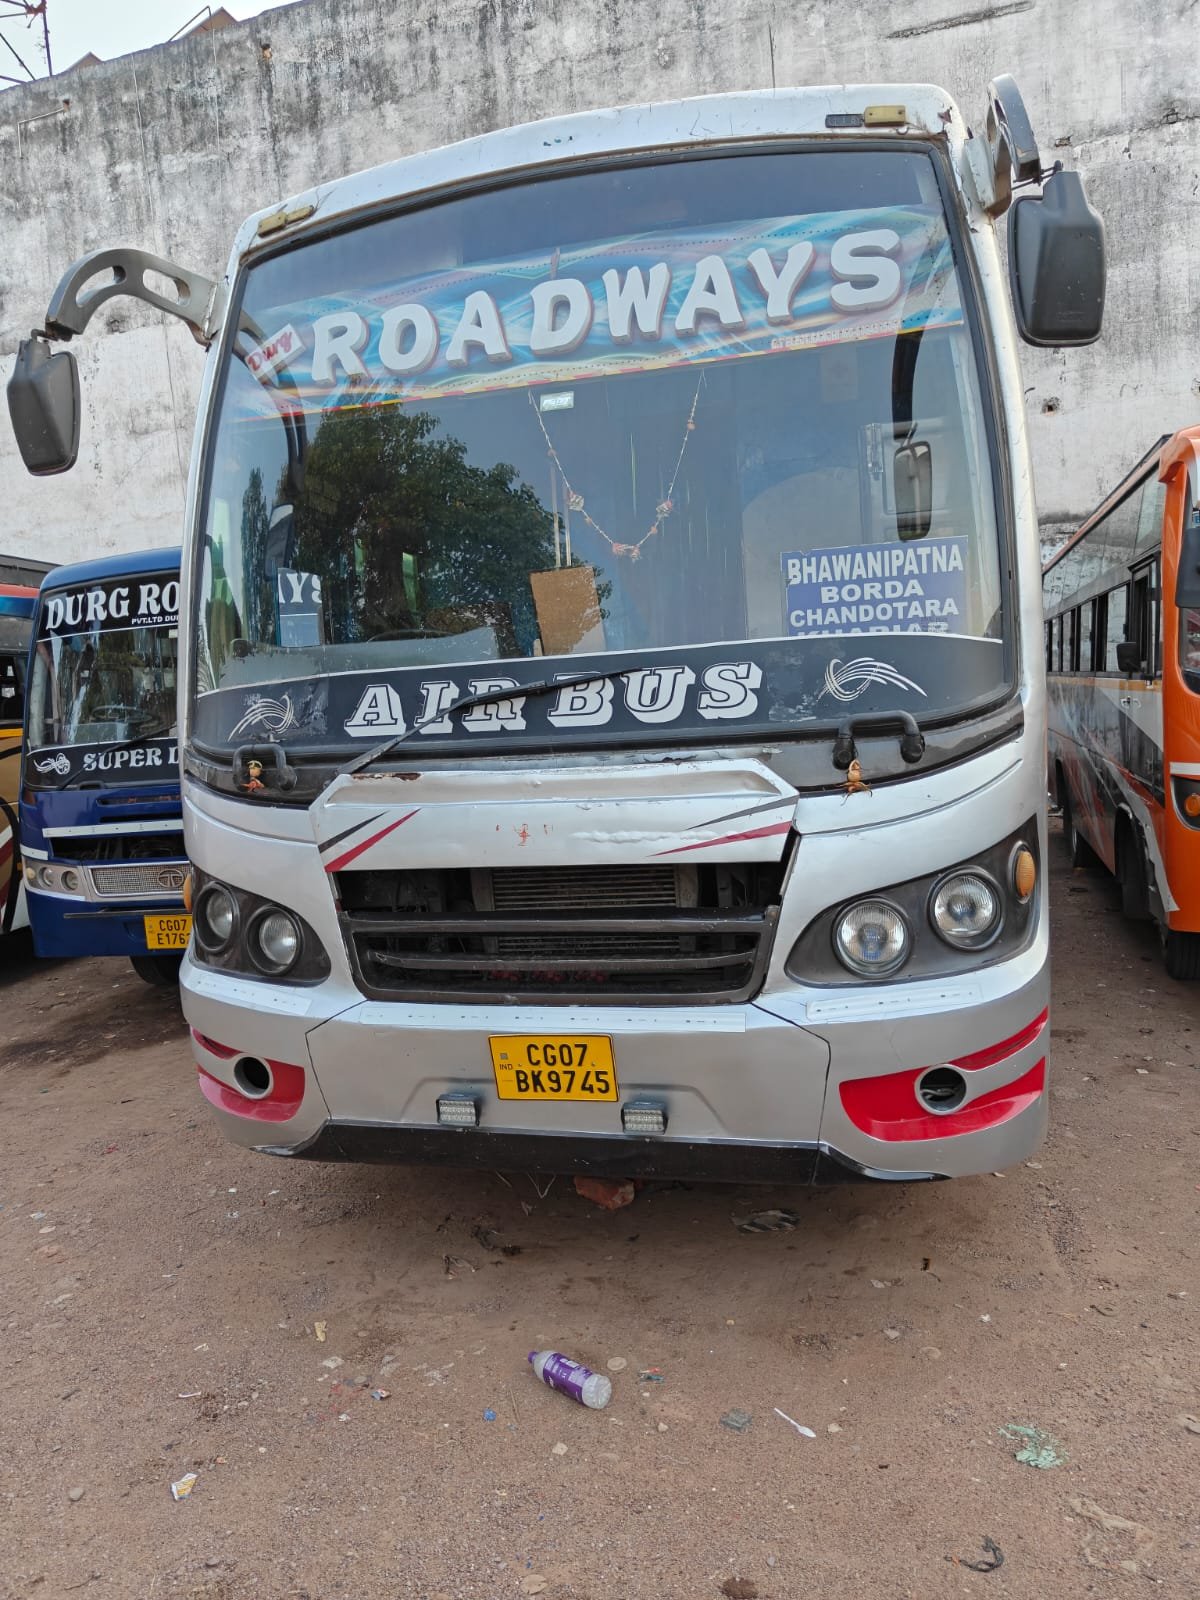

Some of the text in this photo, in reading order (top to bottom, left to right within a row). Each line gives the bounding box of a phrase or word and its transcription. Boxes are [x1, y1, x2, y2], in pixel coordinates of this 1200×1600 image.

[311, 228, 902, 387] ROADWAYS
[787, 544, 964, 586] BHAWANIPATNA
[820, 579, 925, 604] BORDA
[45, 586, 130, 631] DURG
[790, 598, 959, 628] CHANDOTARA
[344, 662, 763, 737] AIR BUS
[82, 747, 163, 771] SUPER
[159, 919, 187, 931] CG07
[526, 1044, 588, 1067] CG07
[515, 1069, 610, 1094] BK9745
